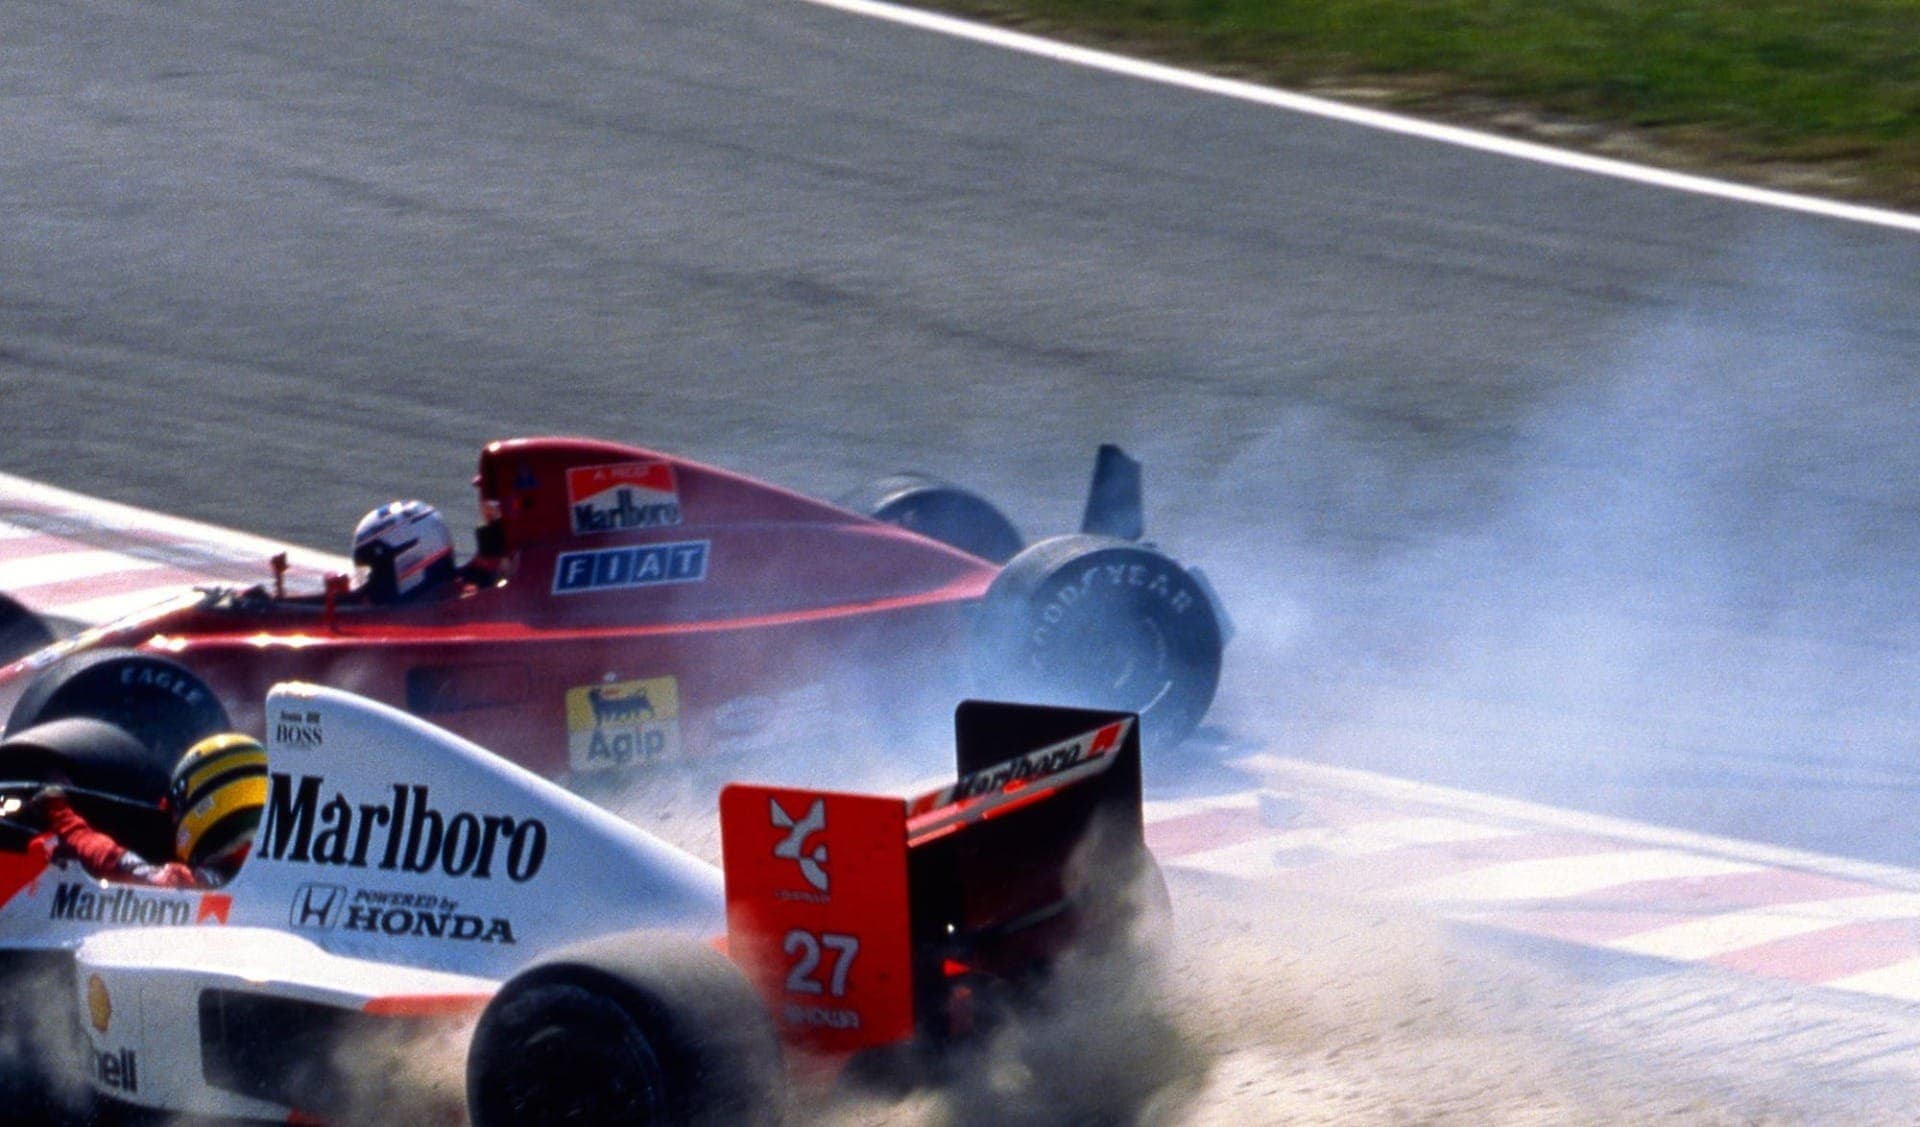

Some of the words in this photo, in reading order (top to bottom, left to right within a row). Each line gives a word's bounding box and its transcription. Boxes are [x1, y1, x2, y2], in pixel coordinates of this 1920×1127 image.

[566, 550, 700, 584] FIAT
[120, 666, 205, 701] EAGLE
[276, 724, 322, 745] BOSS
[588, 727, 665, 764] Agip
[256, 772, 547, 883] Marlboro
[50, 882, 190, 926] Marlboro
[355, 887, 438, 909] POWERED
[344, 905, 517, 944] HONDA
[783, 929, 859, 997] 27
